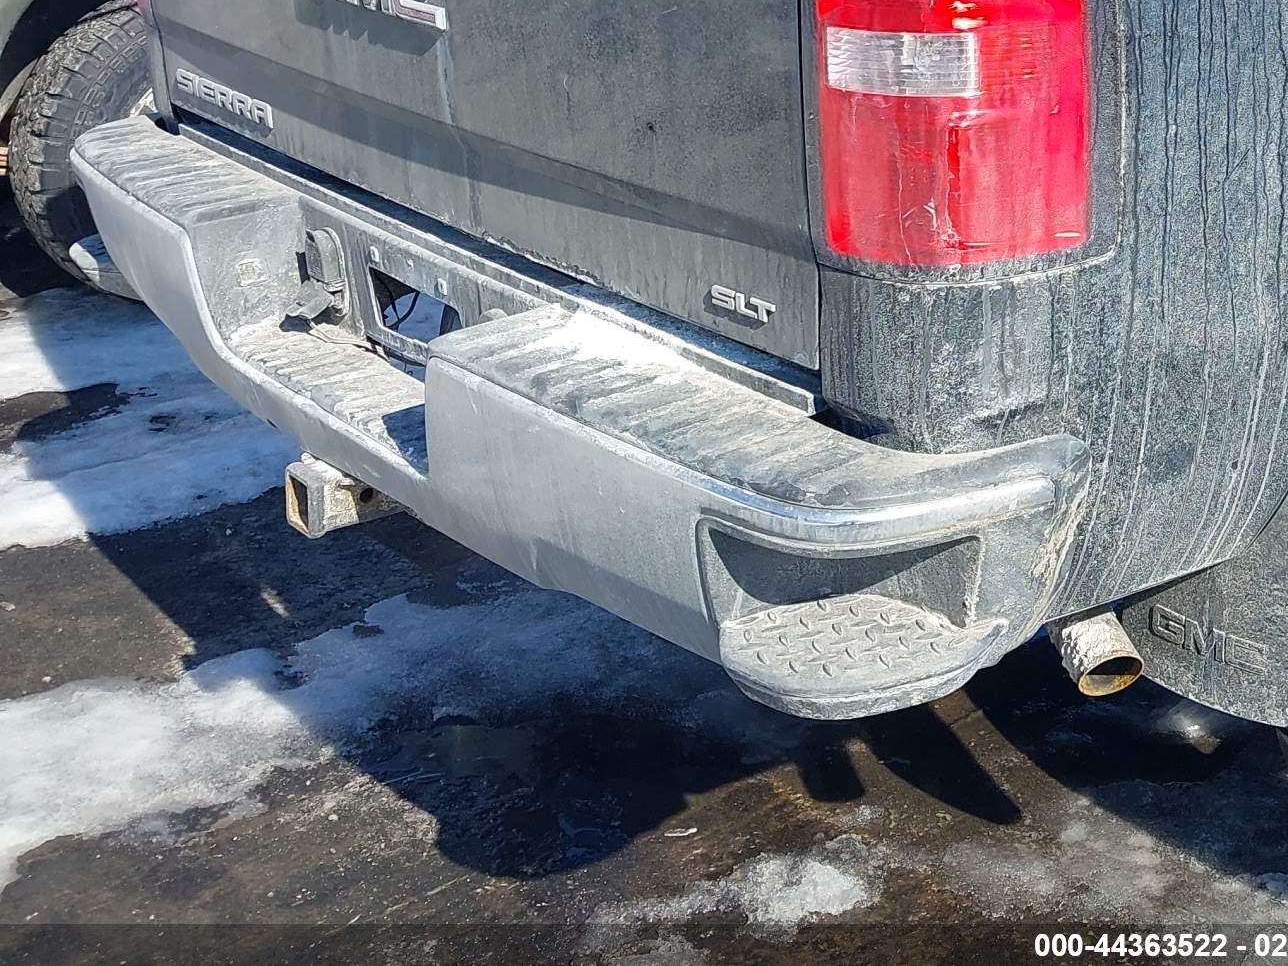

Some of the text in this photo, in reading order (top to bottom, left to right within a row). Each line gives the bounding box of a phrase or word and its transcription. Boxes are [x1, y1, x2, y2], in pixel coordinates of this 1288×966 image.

[176, 68, 274, 130] SIERRA
[711, 284, 777, 323] SLT
[1151, 604, 1267, 676] GMC
